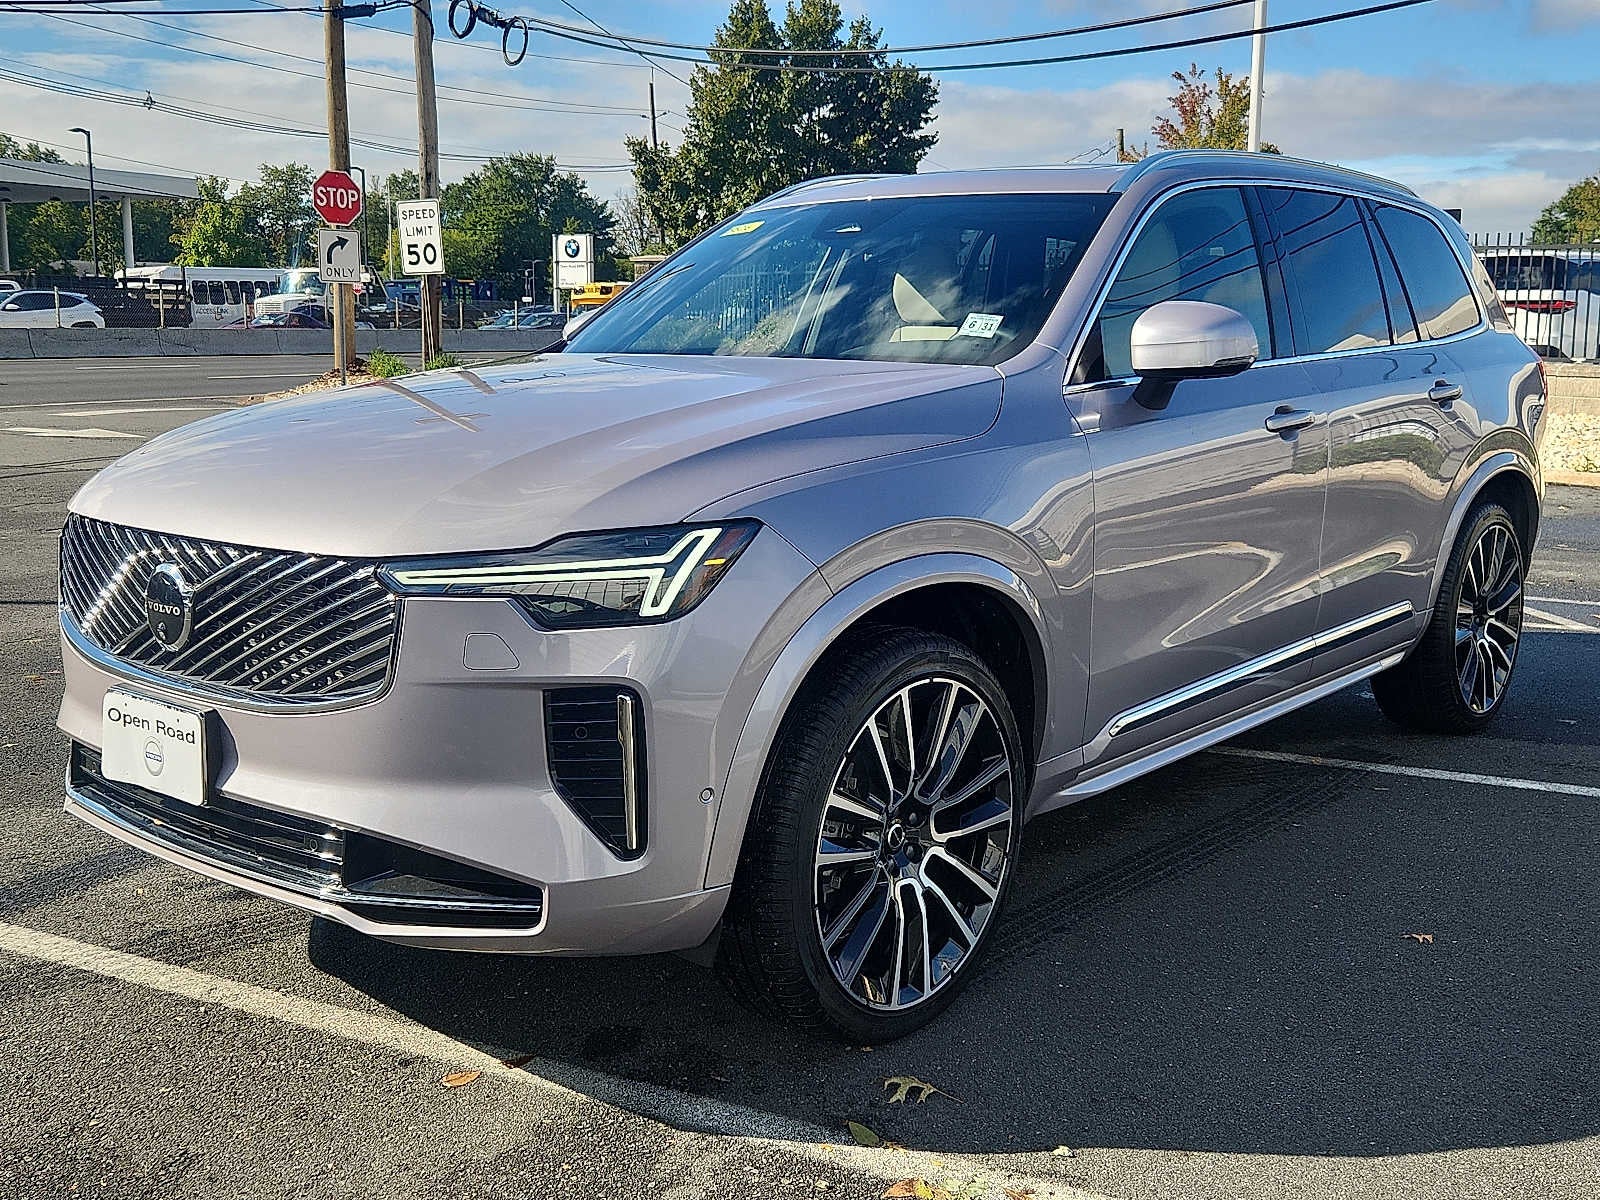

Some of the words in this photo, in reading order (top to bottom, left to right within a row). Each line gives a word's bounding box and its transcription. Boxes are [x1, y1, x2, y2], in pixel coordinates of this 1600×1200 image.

[316, 186, 359, 209] STOP
[401, 208, 436, 220] SPEED
[405, 225, 433, 237] LIMIT
[407, 242, 437, 266] 50
[326, 267, 354, 278] ONLY
[981, 323, 993, 331] 31
[148, 601, 181, 616] VOLVO
[107, 707, 150, 731] Open
[156, 719, 196, 745] Road
